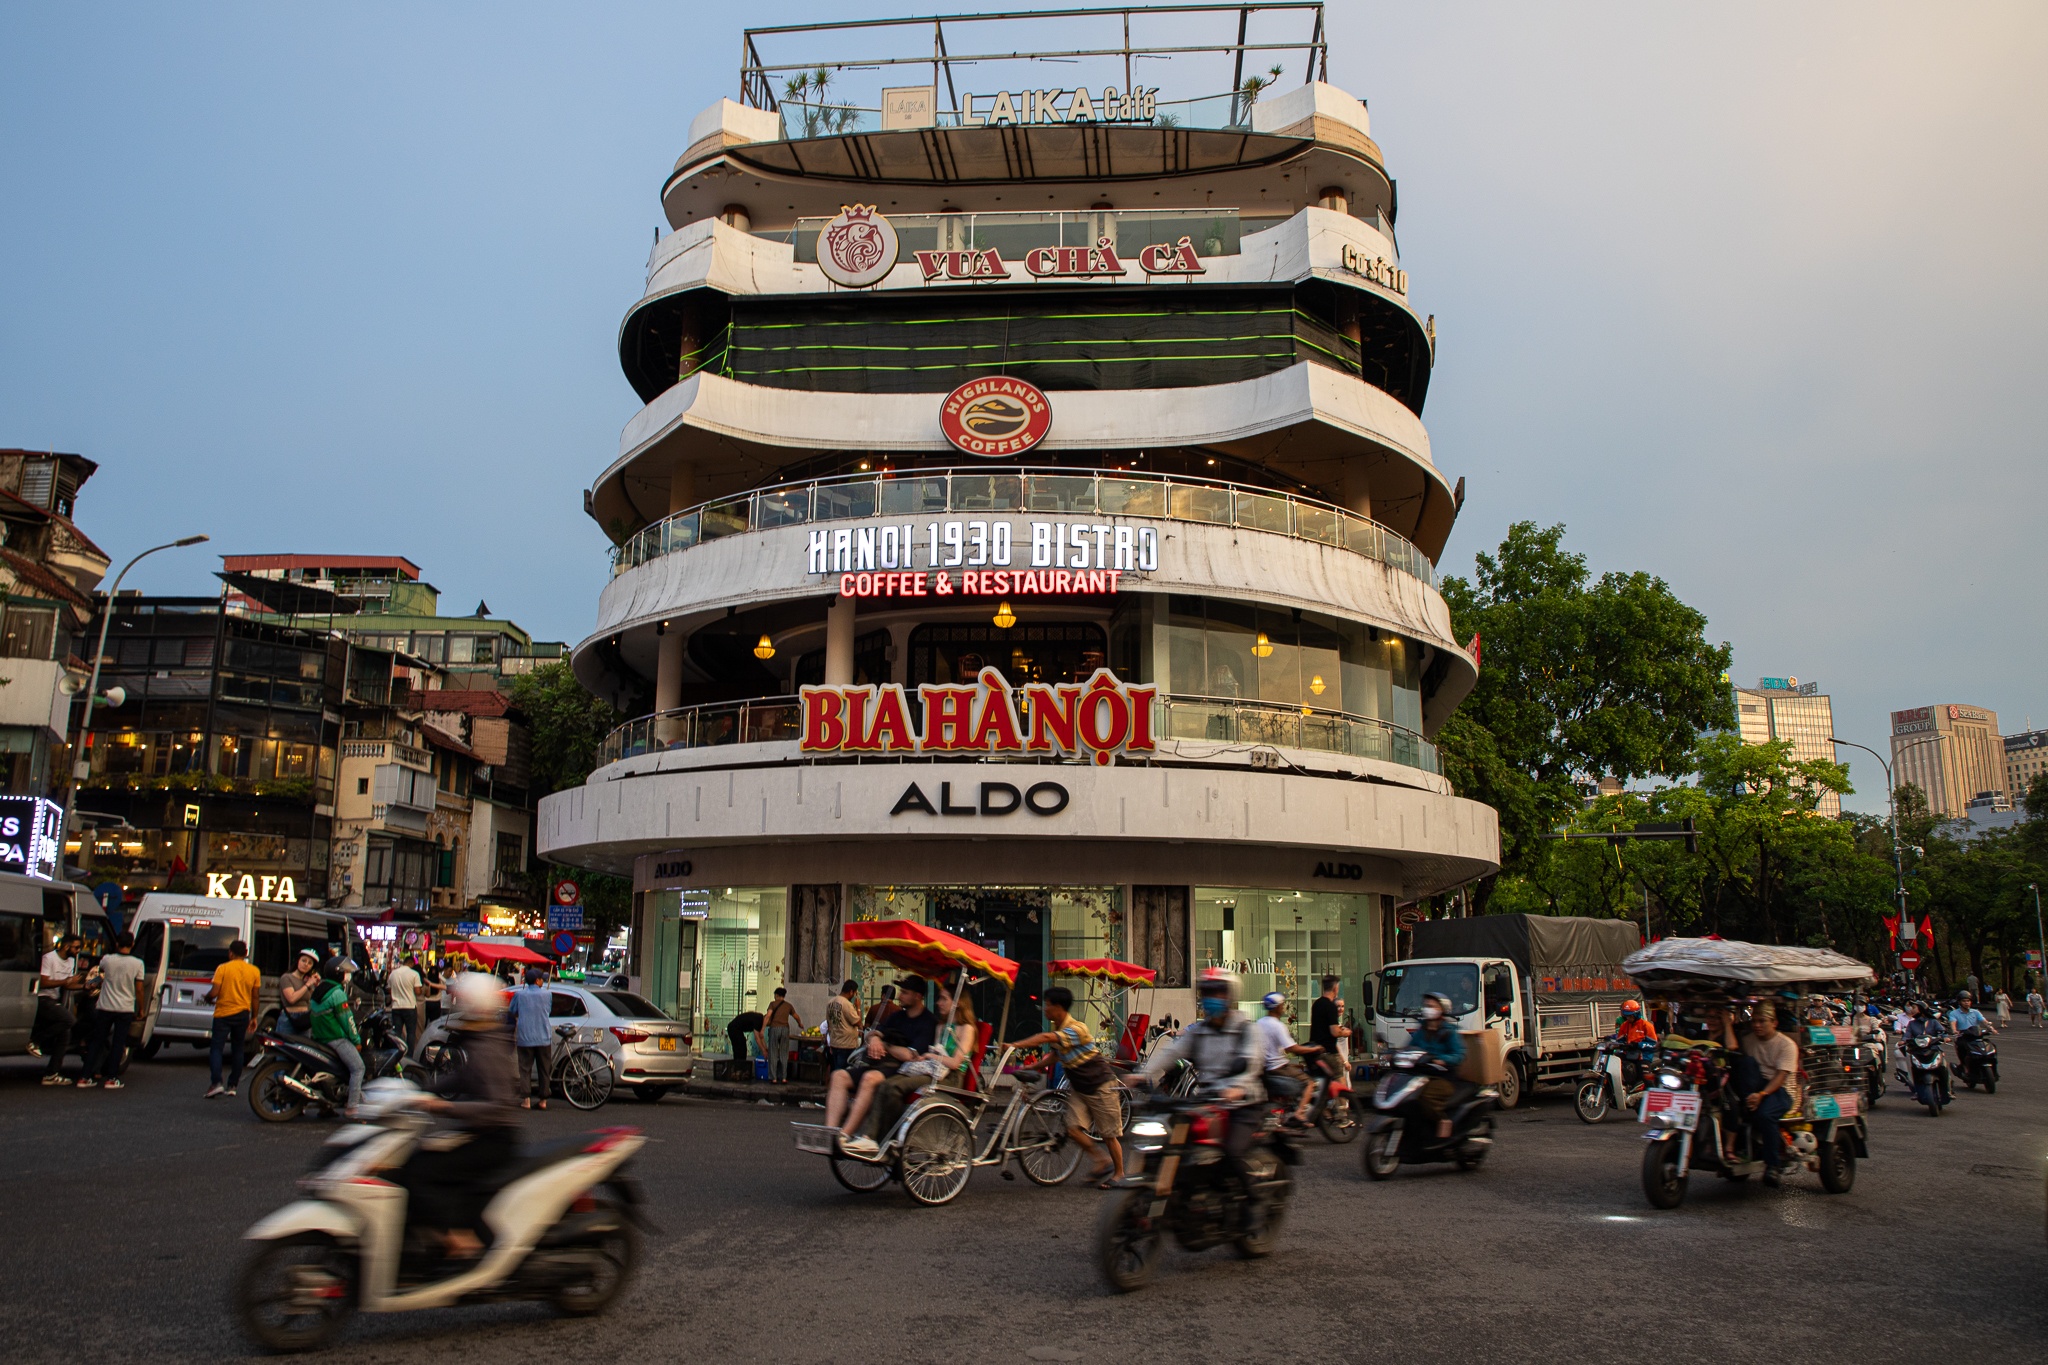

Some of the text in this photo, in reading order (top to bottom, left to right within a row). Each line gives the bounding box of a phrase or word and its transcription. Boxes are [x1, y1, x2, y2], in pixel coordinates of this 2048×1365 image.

[962, 85, 1160, 126] LAIKA Café
[912, 236, 1207, 281] VUA CHẢ CÁ
[946, 381, 1045, 416] HIGHLANDS
[958, 432, 1035, 454] COFFEE
[808, 520, 1159, 575] HANOI 1930 BISTRO
[839, 570, 1122, 597] COFFEE & RESTAURANT
[802, 670, 1157, 766] BIA HÀ NỘI
[1896, 722, 1931, 735] GROUP
[889, 780, 1070, 816] ALDO
[0, 816, 20, 836] S
[654, 860, 692, 879] ALDO
[1313, 861, 1363, 881] ALDO
[205, 872, 298, 903] KAFA
